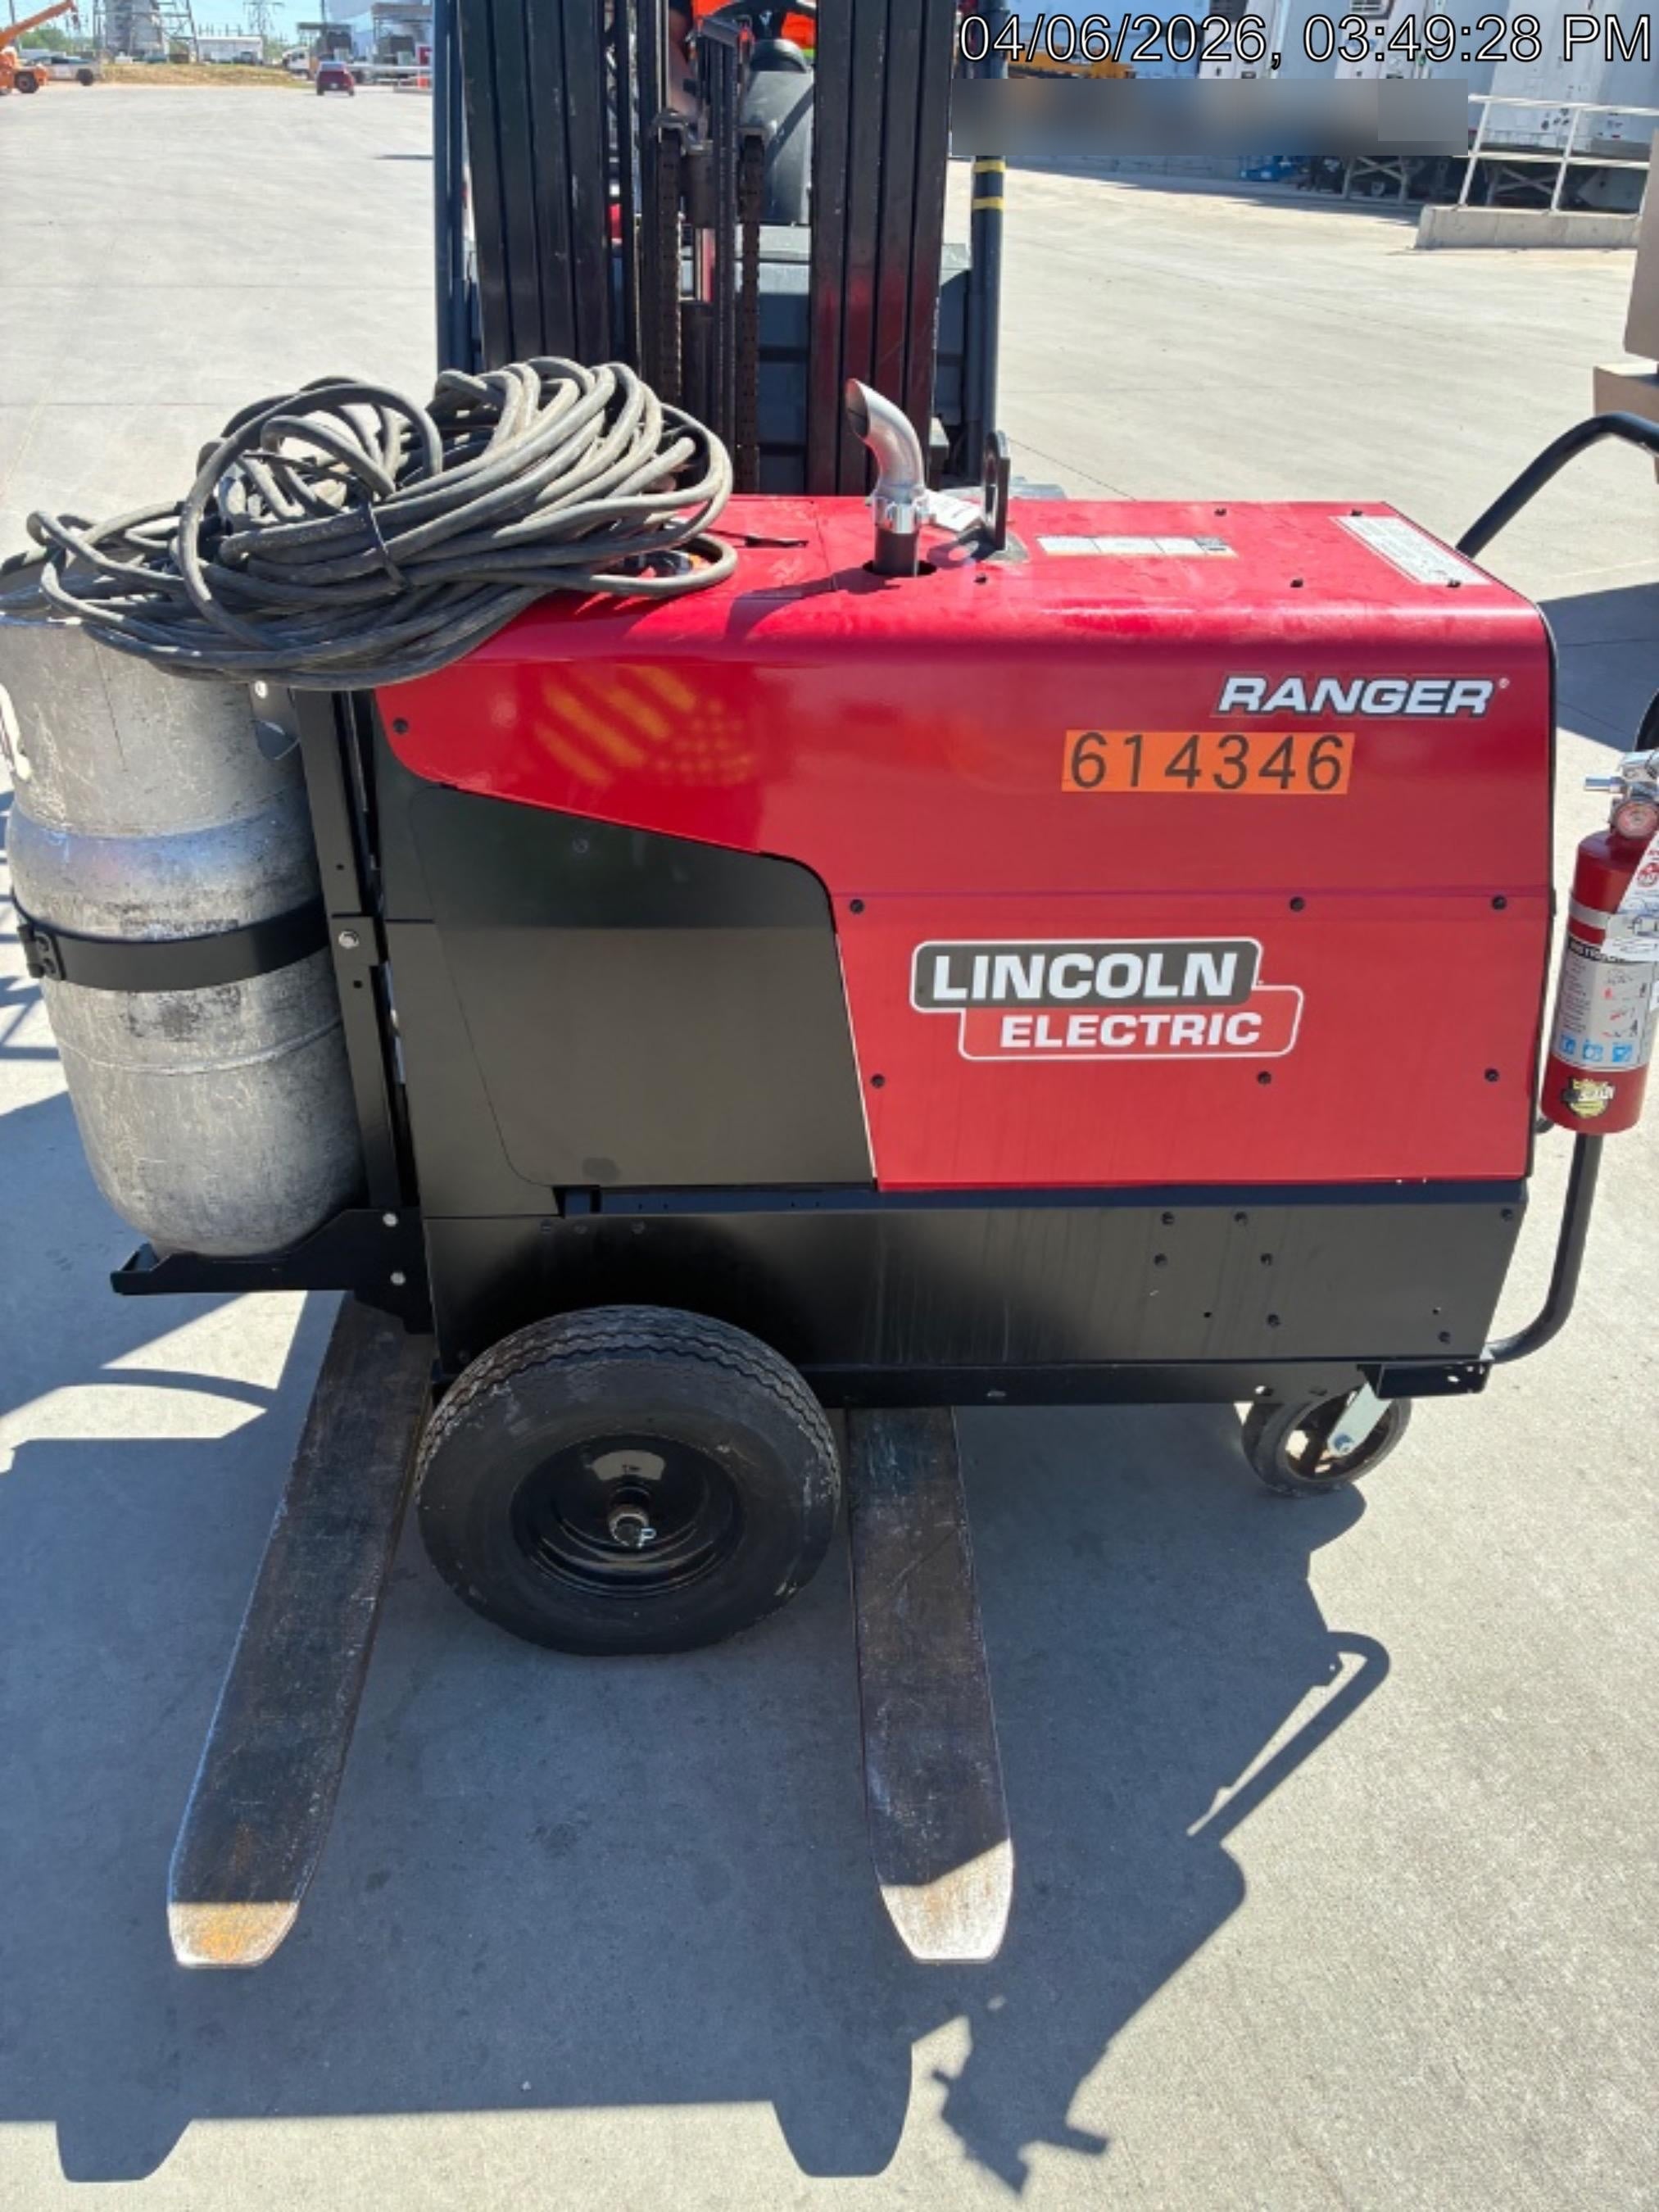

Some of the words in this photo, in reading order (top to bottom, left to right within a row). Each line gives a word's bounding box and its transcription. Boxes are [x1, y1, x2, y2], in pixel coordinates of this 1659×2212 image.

[1071, 732, 1344, 791] 614346
[931, 951, 1239, 1001] LINCOLN
[999, 1013, 1262, 1049] ELECTRIC
